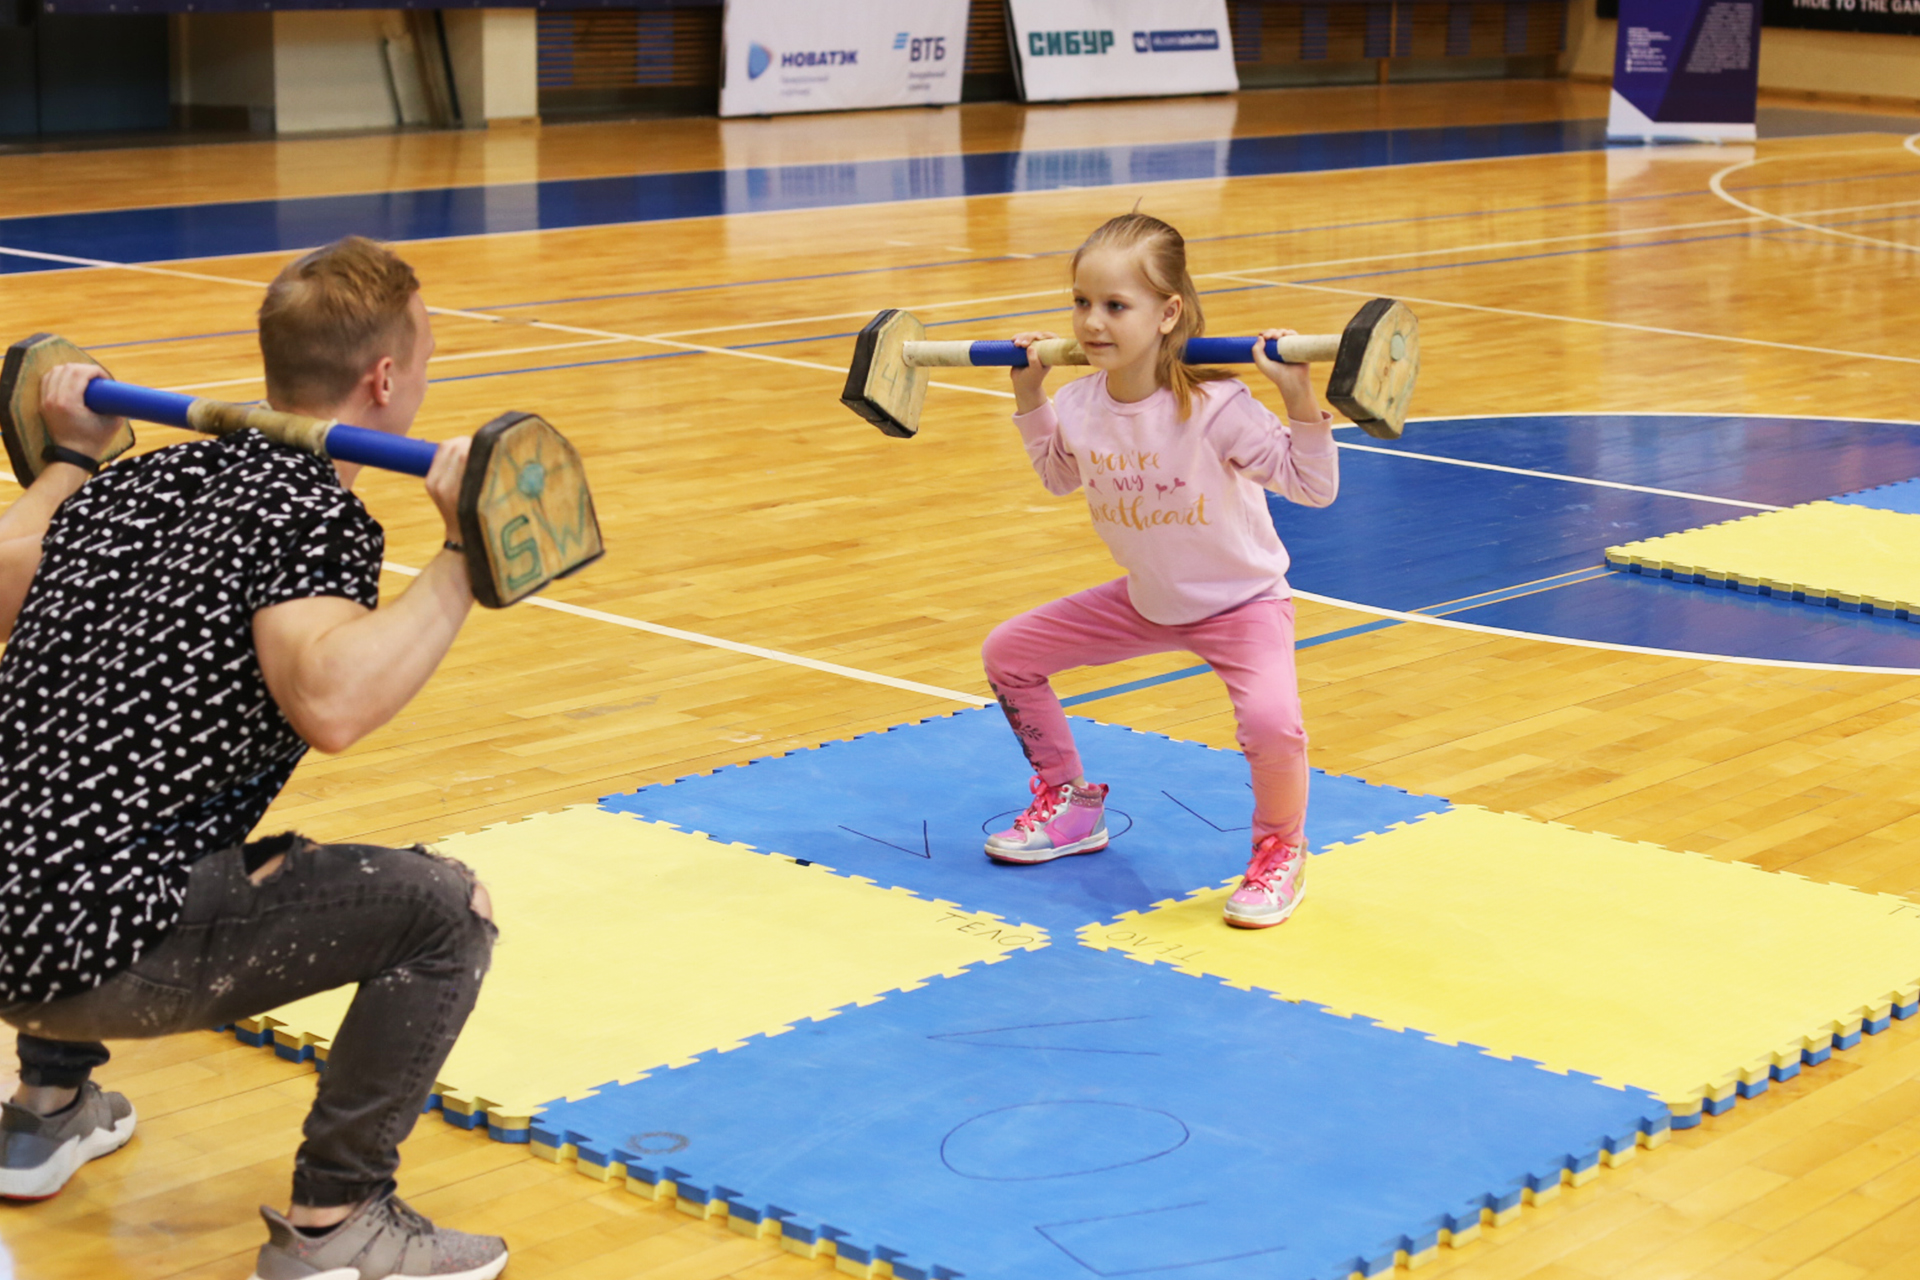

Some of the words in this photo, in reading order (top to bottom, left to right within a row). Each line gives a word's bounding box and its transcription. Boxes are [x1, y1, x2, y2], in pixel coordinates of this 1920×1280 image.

[1836, 0, 1856, 11] TO
[1861, 0, 1888, 13] THE
[909, 37, 946, 62] ВТБ
[1028, 30, 1114, 56] СИБУР
[781, 50, 858, 67] НОВАТЭК
[1112, 474, 1144, 492] my
[1089, 493, 1212, 531] weetheart
